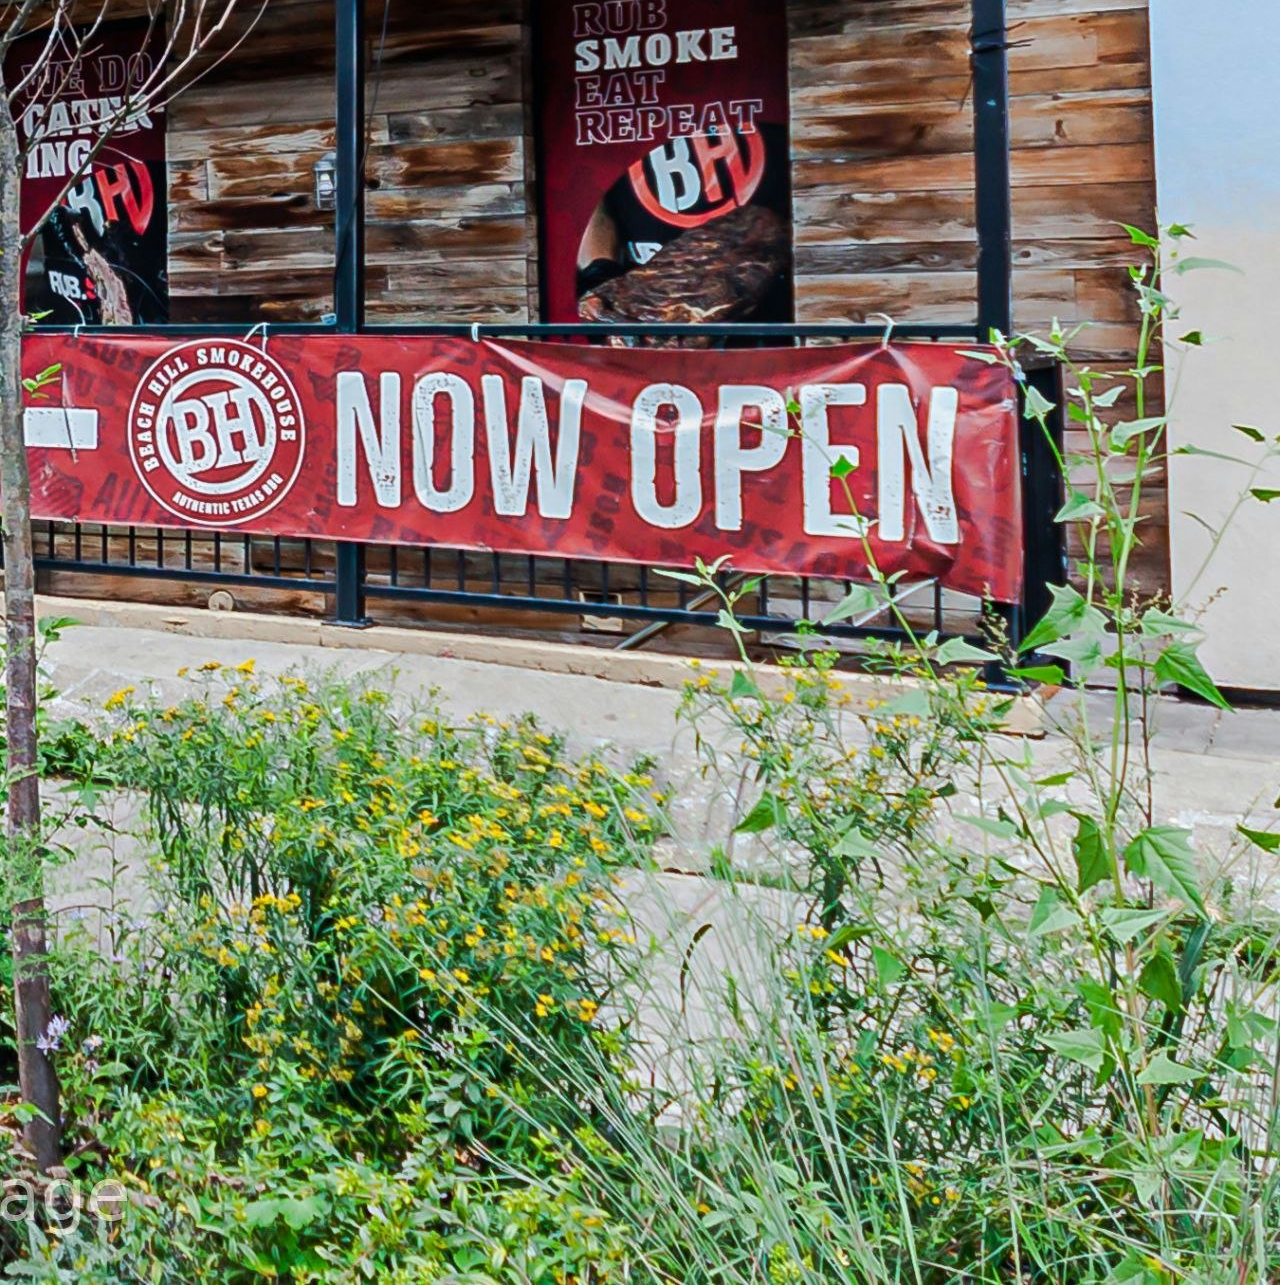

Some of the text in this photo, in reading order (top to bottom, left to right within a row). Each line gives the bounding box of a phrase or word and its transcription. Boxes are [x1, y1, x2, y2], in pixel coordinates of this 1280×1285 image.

[575, 26, 738, 72] SMOKE
[21, 52, 153, 98] WE DO
[575, 70, 665, 109] EAT
[575, 99, 763, 145] REPEAT
[26, 140, 93, 179] ING
[147, 356, 190, 398] HILL
[196, 347, 298, 442] SMOKEHOUSE
[136, 400, 161, 474] BEACH
[336, 371, 589, 520] NOW
[630, 382, 960, 545] OPEN
[171, 490, 230, 515] AUTHENTIC
[232, 489, 266, 514] TEXAS
[262, 472, 284, 496] BBQ
